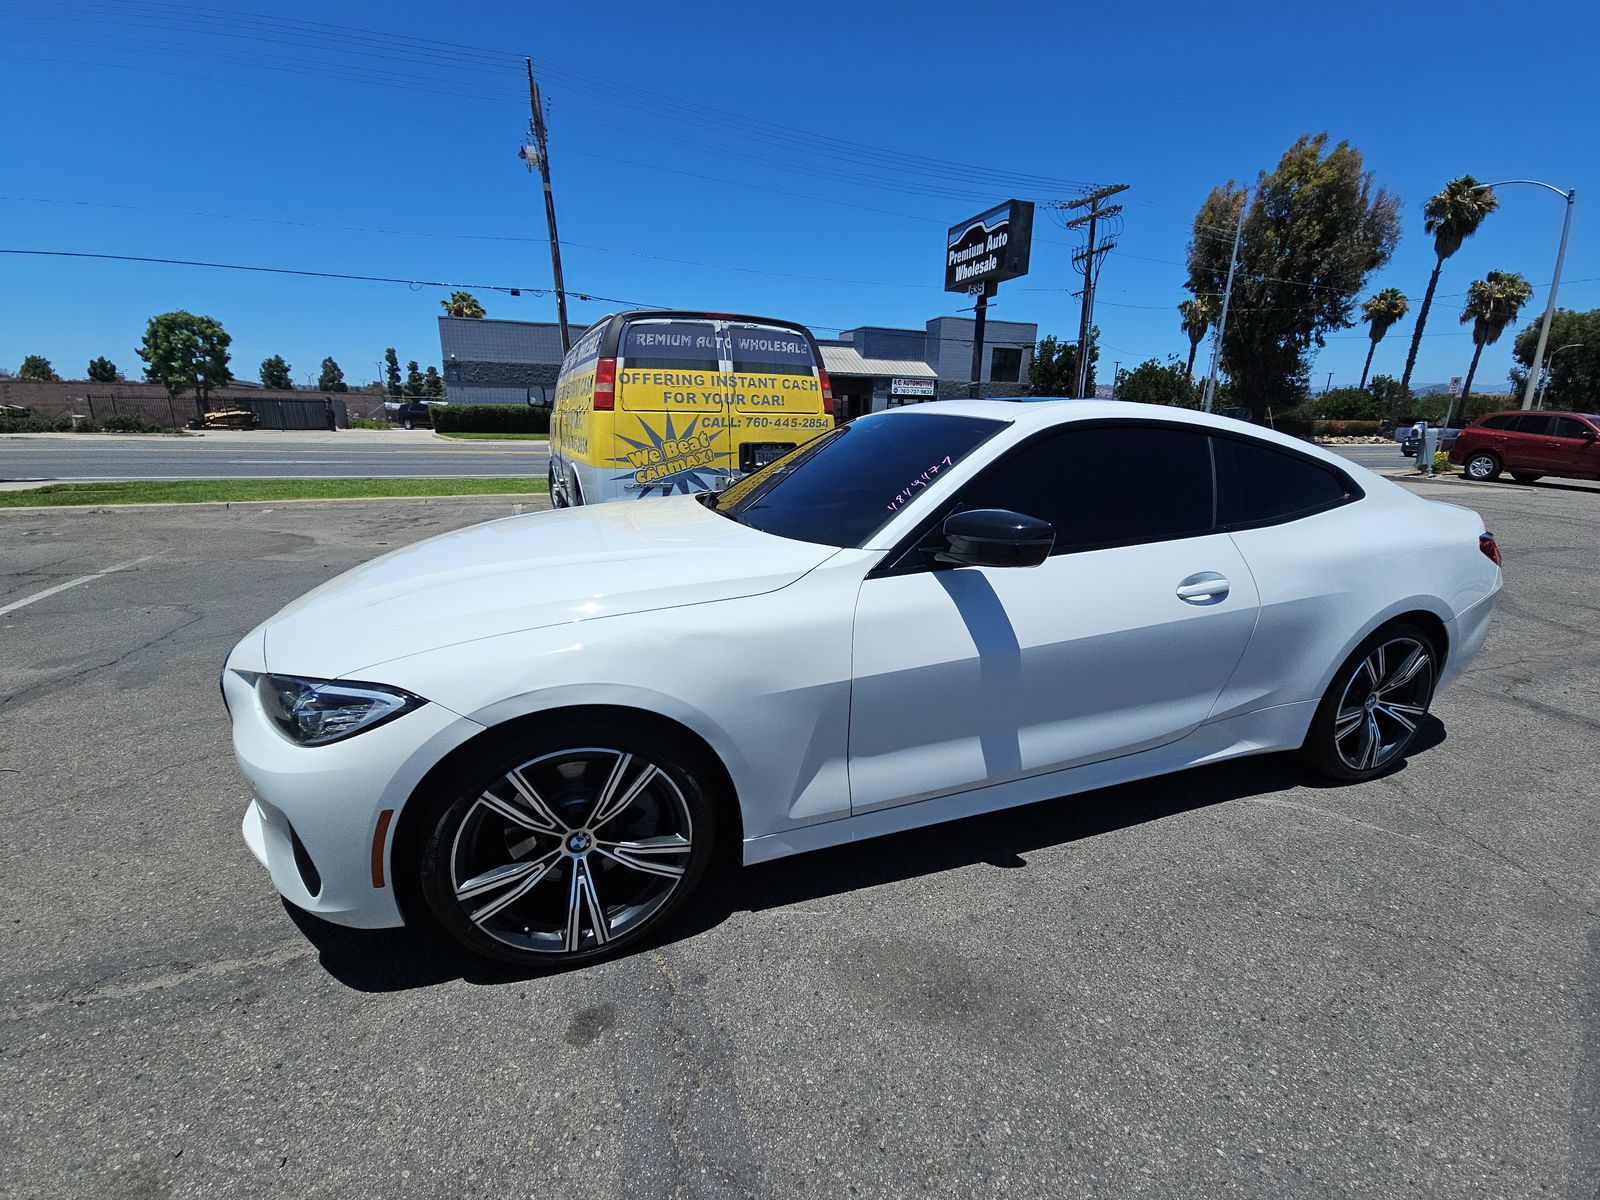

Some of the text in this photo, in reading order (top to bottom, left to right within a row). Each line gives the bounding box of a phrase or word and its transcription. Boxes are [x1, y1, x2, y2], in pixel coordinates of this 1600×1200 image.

[949, 232, 1008, 266] Premium Auto
[955, 253, 997, 282] Wholesale
[696, 335, 732, 349] AUTO
[738, 338, 808, 354] WHOLESALE
[618, 372, 819, 392] OFFERING INSTANT CASH
[663, 392, 785, 407] FOR YOUR CAR!
[701, 417, 829, 429] CALL: 760-445-2854
[626, 430, 710, 469] We Beat
[635, 449, 714, 484] CARMAX!
